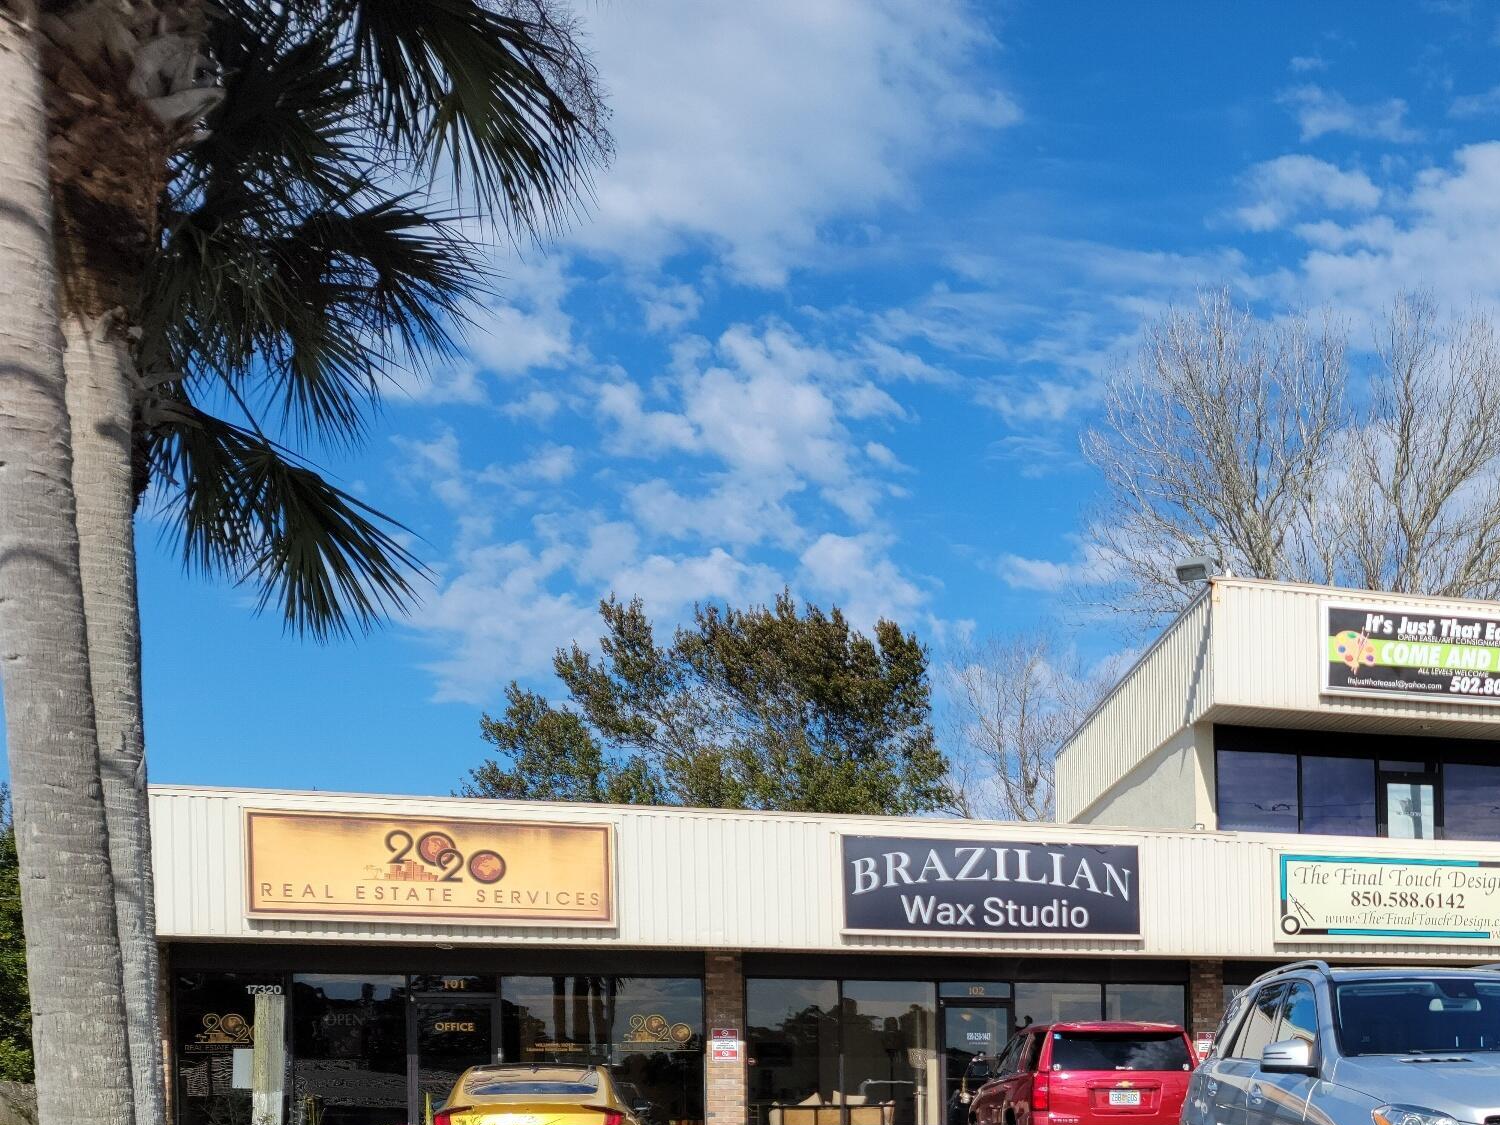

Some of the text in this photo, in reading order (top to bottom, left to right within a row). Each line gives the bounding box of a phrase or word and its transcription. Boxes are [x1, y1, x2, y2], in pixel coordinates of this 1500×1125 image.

[1365, 613, 1393, 635] It's
[1397, 616, 1436, 638] Just
[1440, 618, 1482, 640] That
[1397, 633, 1418, 642] OPEN
[1381, 641, 1442, 667] COME
[1445, 645, 1492, 670] AND
[1418, 667, 1489, 679] ALL LEVELS WELCOME
[384, 829, 506, 884] 2020
[851, 847, 1131, 902] BRAZILIAN
[1293, 864, 1330, 885] The
[1334, 866, 1384, 886] Final
[1388, 866, 1443, 888] Touch
[260, 882, 600, 906] REAL ESTATE SERVICES
[1350, 890, 1465, 909] 850.588.6142
[900, 894, 1090, 929] Wax Studio
[245, 984, 283, 995] 17320
[443, 979, 465, 989] 101
[968, 986, 985, 996] 102
[202, 1013, 254, 1043] 202
[434, 1022, 475, 1032] OFFICE
